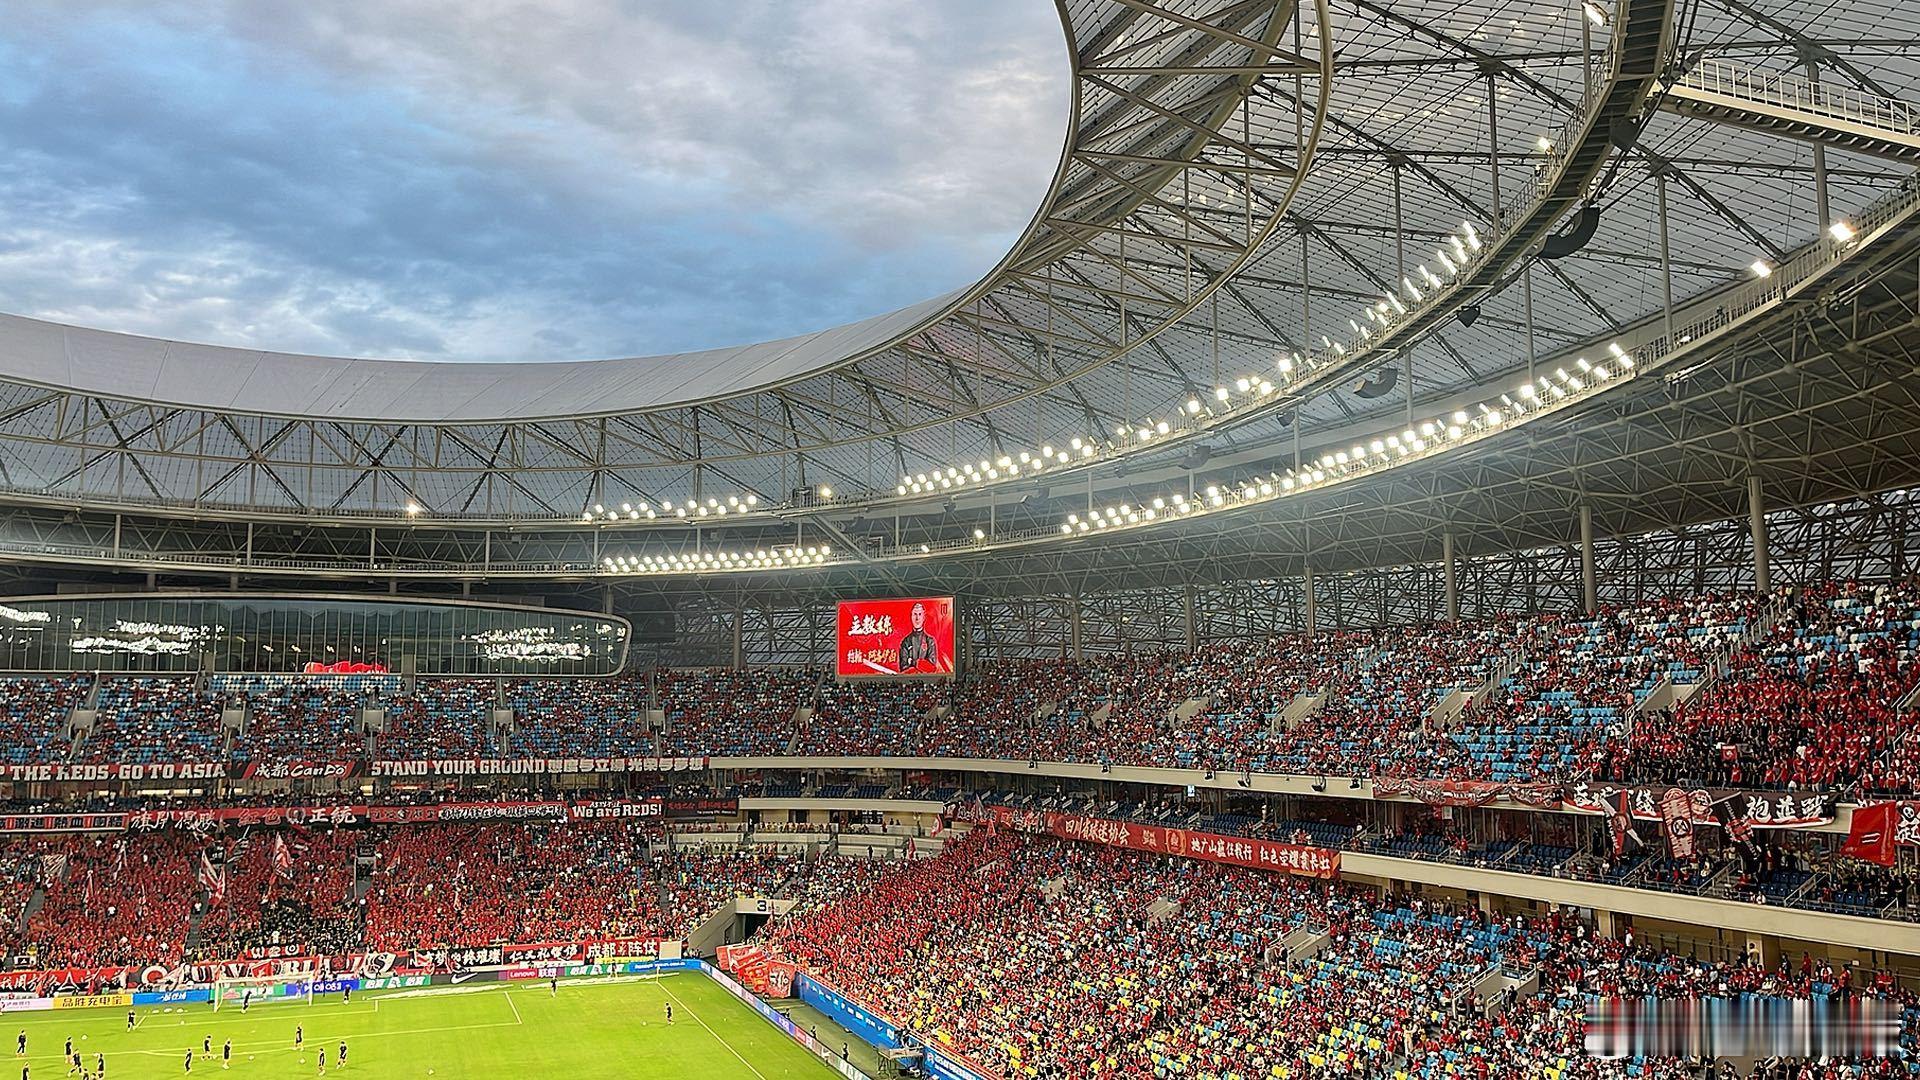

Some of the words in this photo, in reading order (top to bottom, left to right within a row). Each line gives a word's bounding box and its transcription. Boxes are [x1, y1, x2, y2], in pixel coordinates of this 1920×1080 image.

[848, 614, 893, 636] 主教练
[10, 765, 52, 781] THE
[118, 764, 144, 780] GO
[148, 764, 175, 779] TO
[179, 763, 226, 779] ASIA
[255, 762, 289, 778] 成都
[371, 761, 428, 776] STAND
[432, 760, 476, 775] YOUR
[479, 759, 545, 774] GROUND
[572, 805, 594, 818] We
[596, 808, 621, 818] are
[622, 803, 662, 817] REDS!
[509, 970, 536, 978] Lenovo
